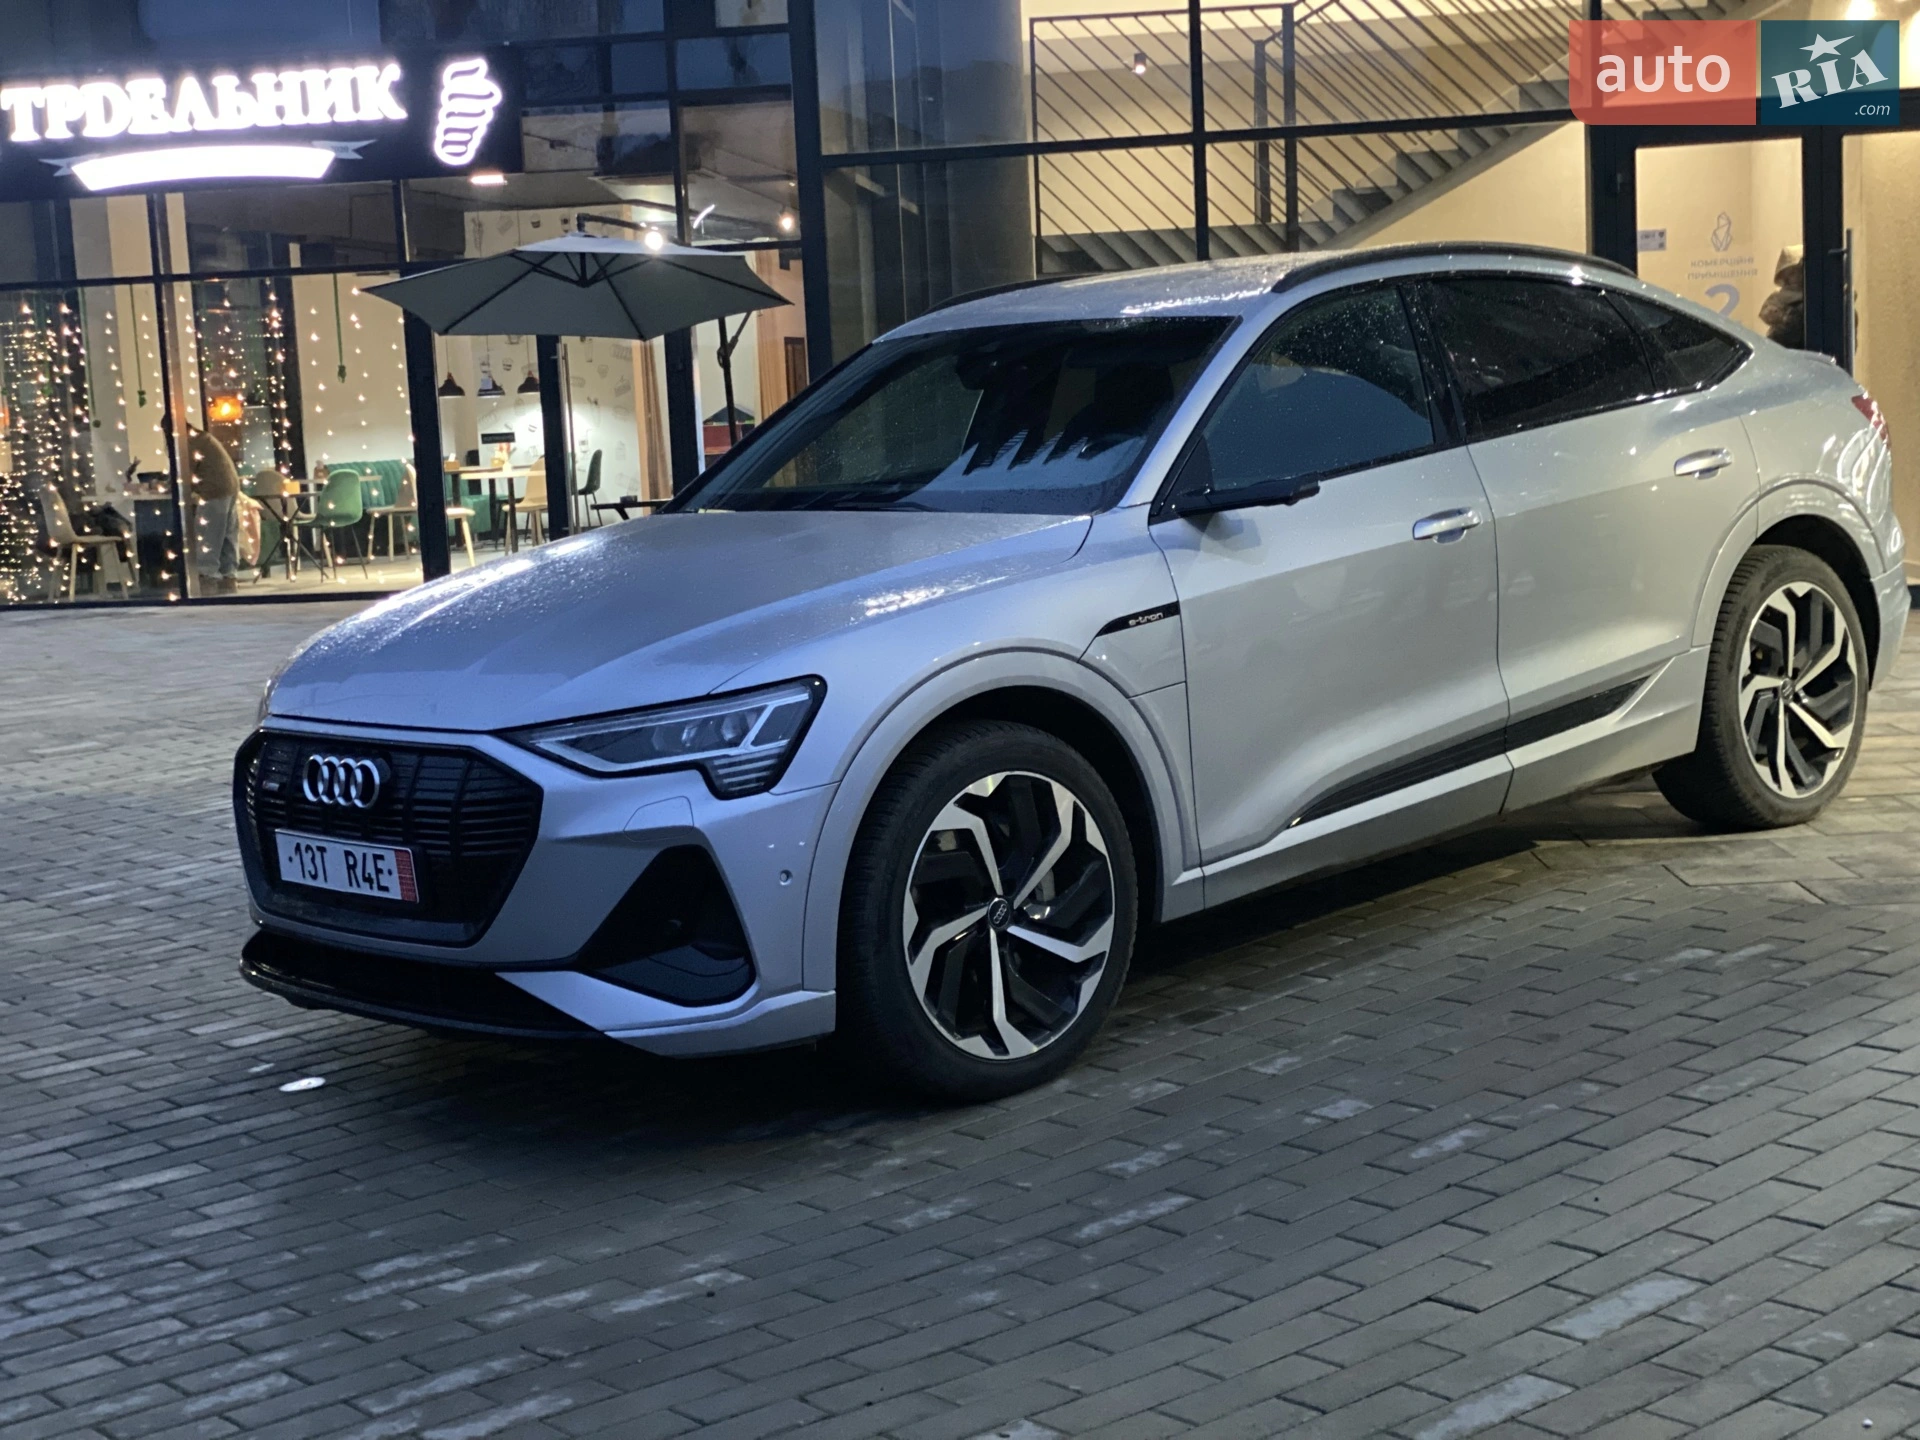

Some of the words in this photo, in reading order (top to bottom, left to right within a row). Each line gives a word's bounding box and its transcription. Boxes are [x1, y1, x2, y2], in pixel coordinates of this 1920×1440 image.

[1128, 612, 1164, 626] e-tron
[294, 841, 328, 883] 13T
[344, 849, 390, 892] R4E
